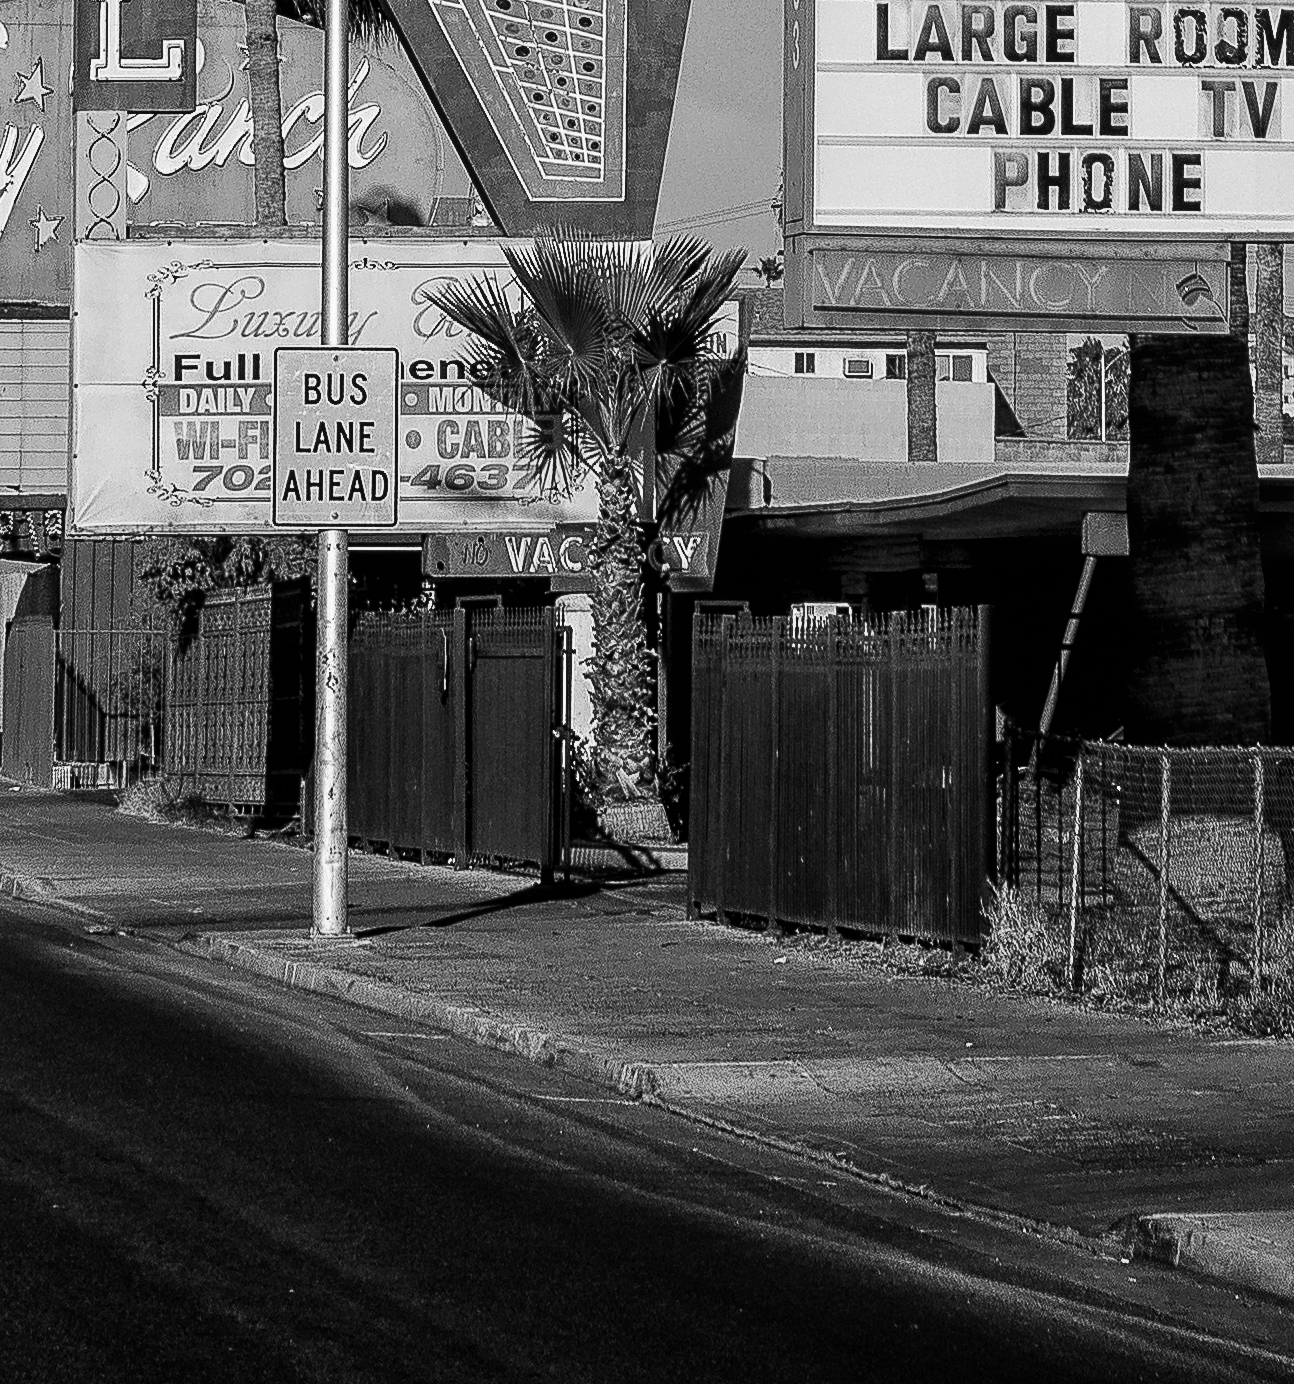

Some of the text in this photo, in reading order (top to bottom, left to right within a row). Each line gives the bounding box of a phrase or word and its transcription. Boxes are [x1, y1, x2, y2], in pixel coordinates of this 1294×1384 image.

[875, 3, 1077, 65] LARGE
[125, 35, 389, 205] anch
[924, 76, 1279, 139] CABLE TV
[992, 151, 1203, 214] PHONE
[814, 256, 1108, 311] VACANCY
[168, 275, 379, 346] Luxuy
[173, 353, 261, 382] Full
[304, 372, 368, 406] BUS
[178, 388, 256, 415] DAILY
[173, 420, 270, 461] WI-FI
[295, 421, 376, 454] LANE
[282, 469, 389, 502] AHEAD
